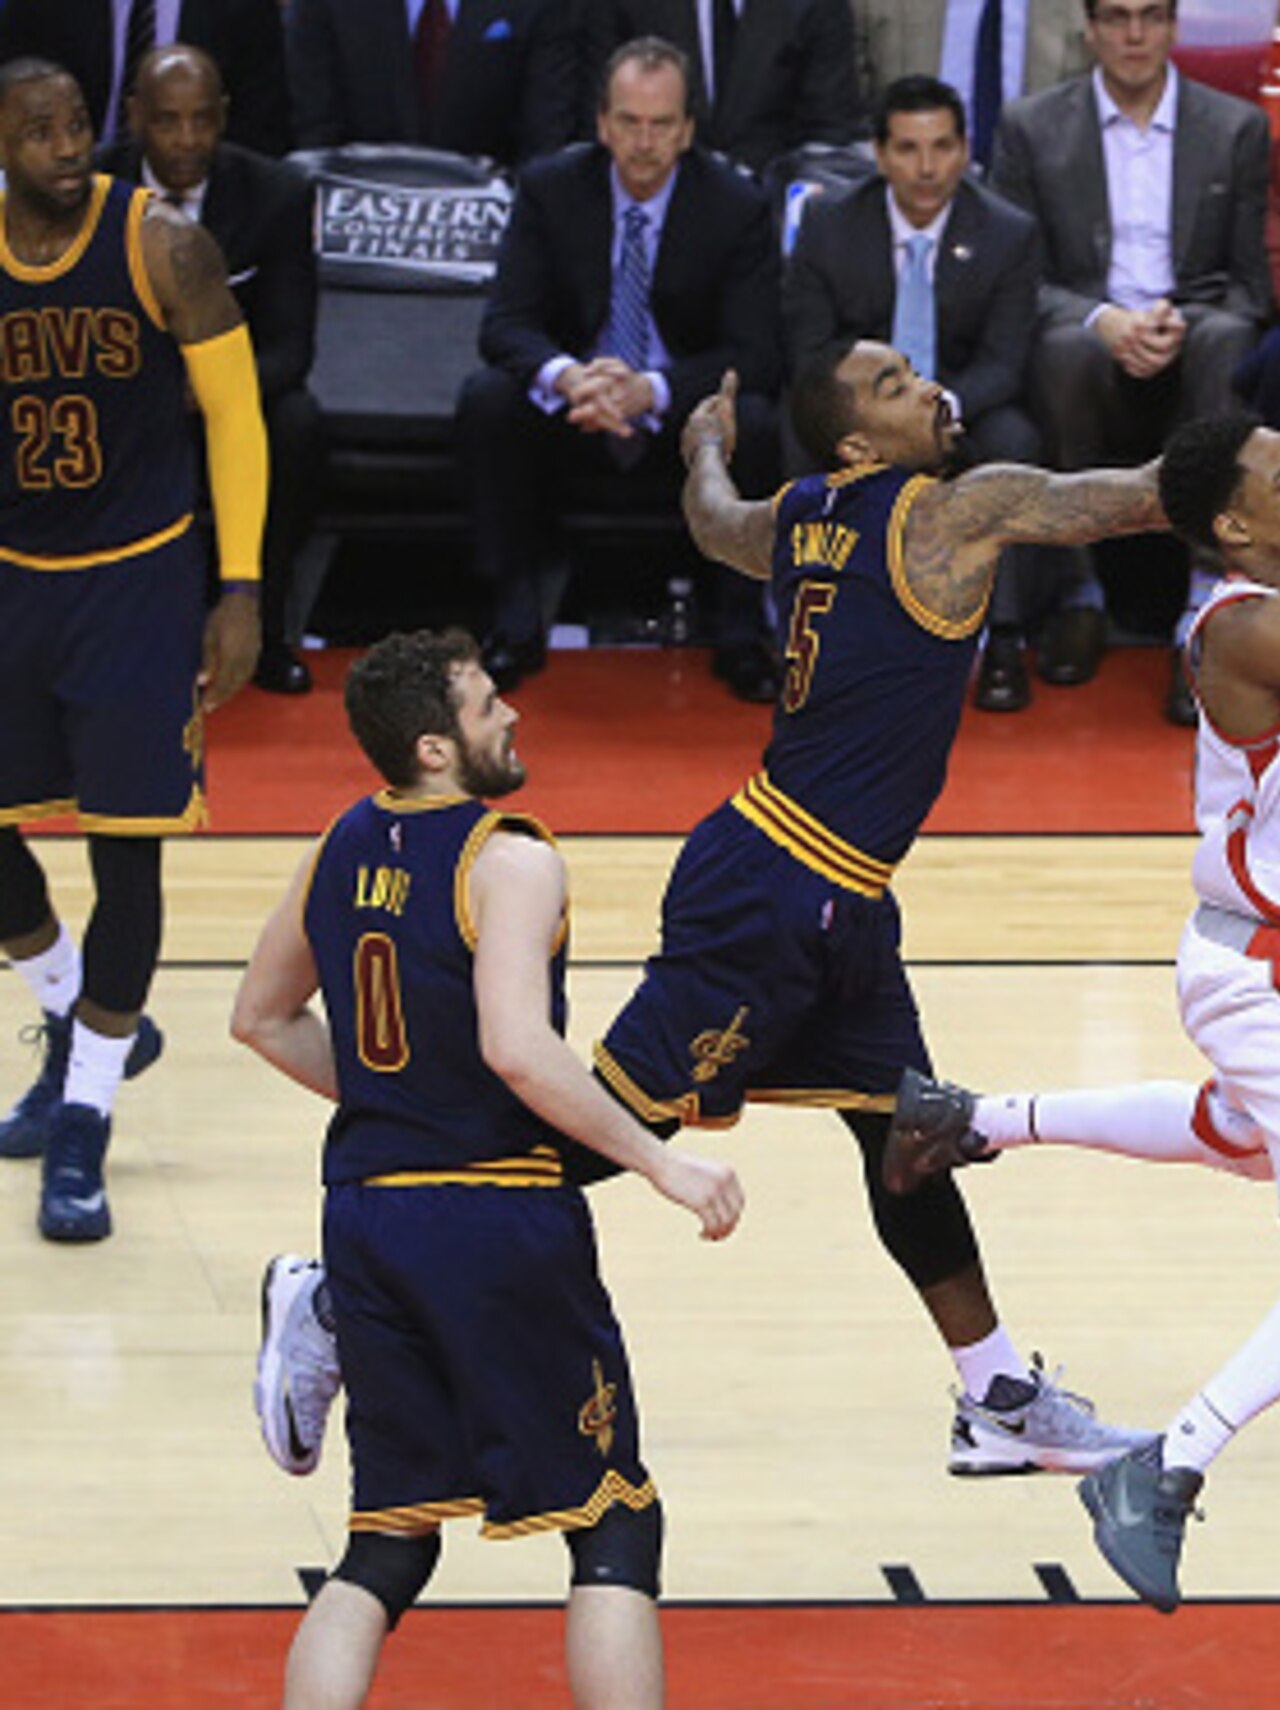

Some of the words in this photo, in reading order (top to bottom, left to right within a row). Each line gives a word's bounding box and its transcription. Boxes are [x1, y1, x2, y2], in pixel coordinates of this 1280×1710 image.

[326, 188, 512, 228] EASTERN
[347, 237, 470, 260] FINALS
[12, 394, 102, 488] 23
[783, 579, 837, 713] 5
[354, 931, 410, 1073] 0
